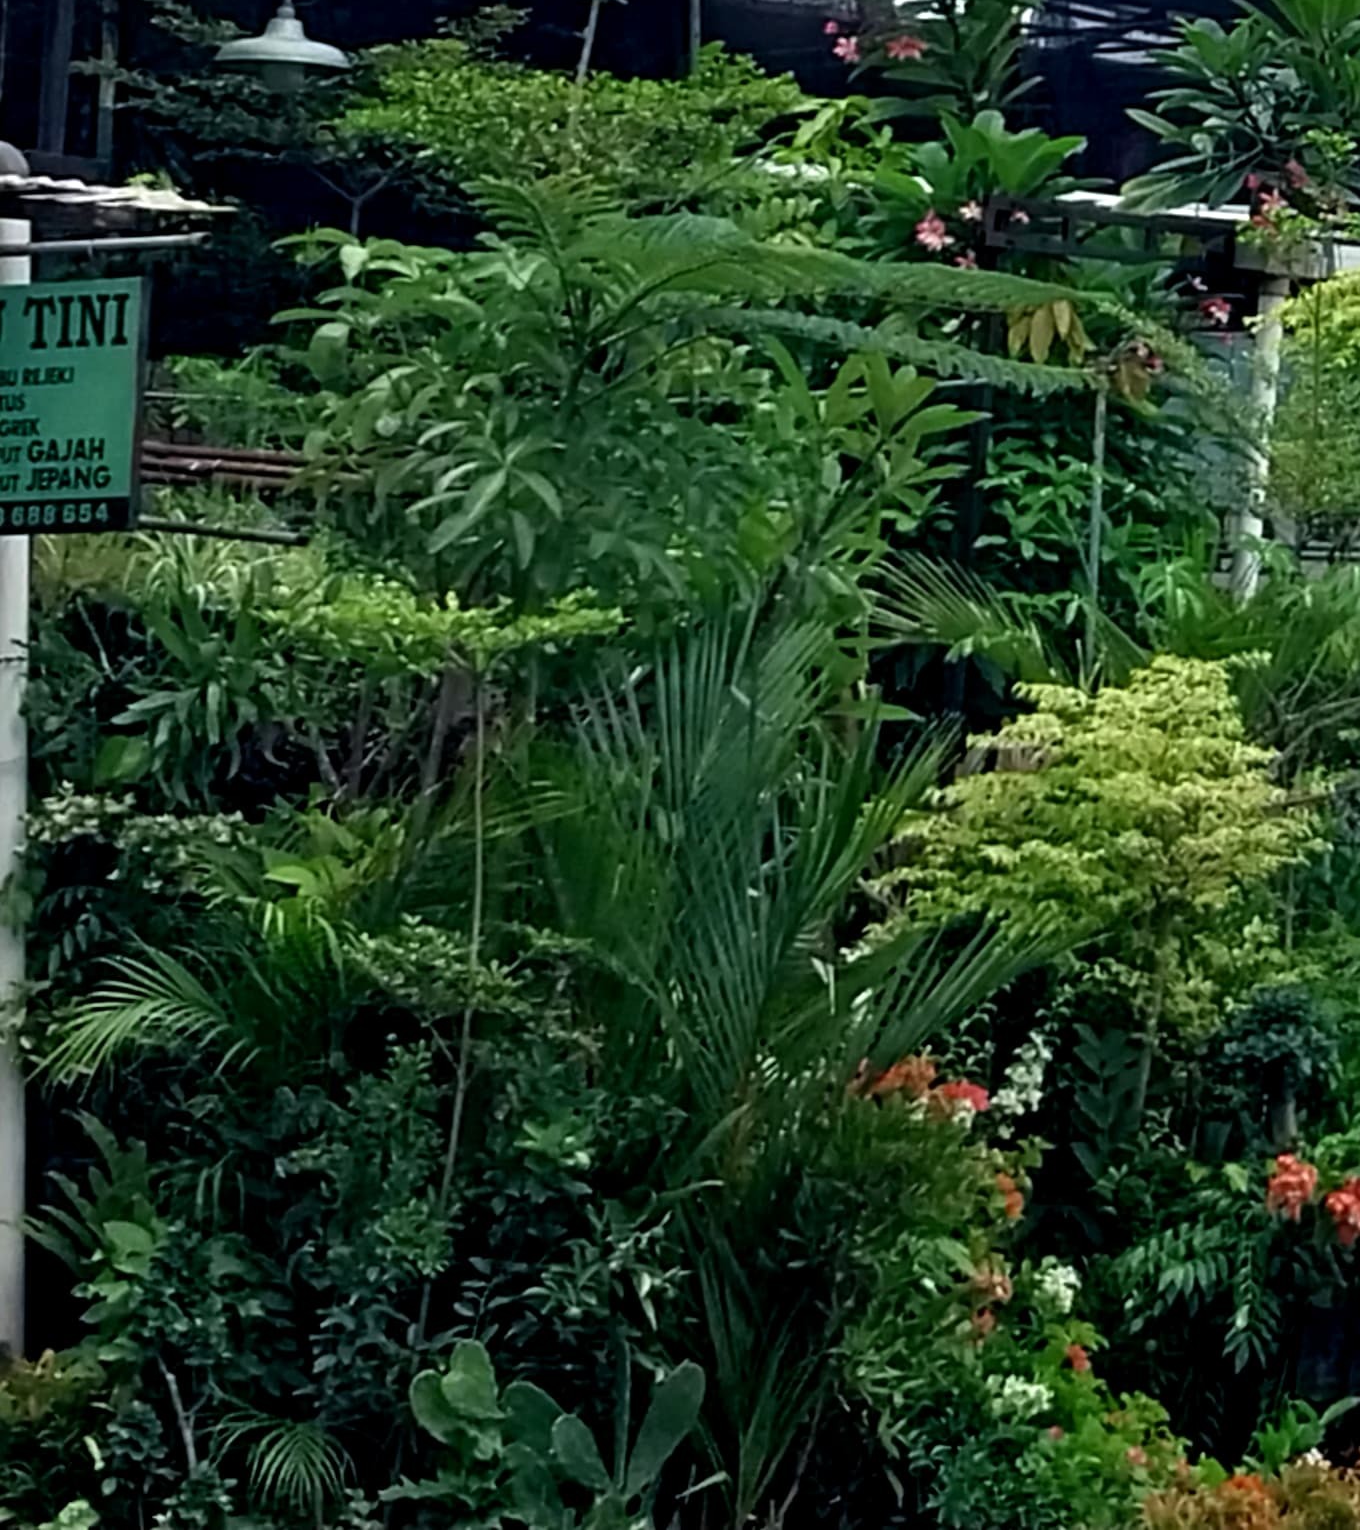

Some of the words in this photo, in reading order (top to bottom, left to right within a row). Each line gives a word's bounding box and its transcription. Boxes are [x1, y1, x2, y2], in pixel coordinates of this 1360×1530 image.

[23, 292, 130, 350] TINI
[27, 438, 105, 463] GAJAH
[25, 466, 111, 492] JEPANG
